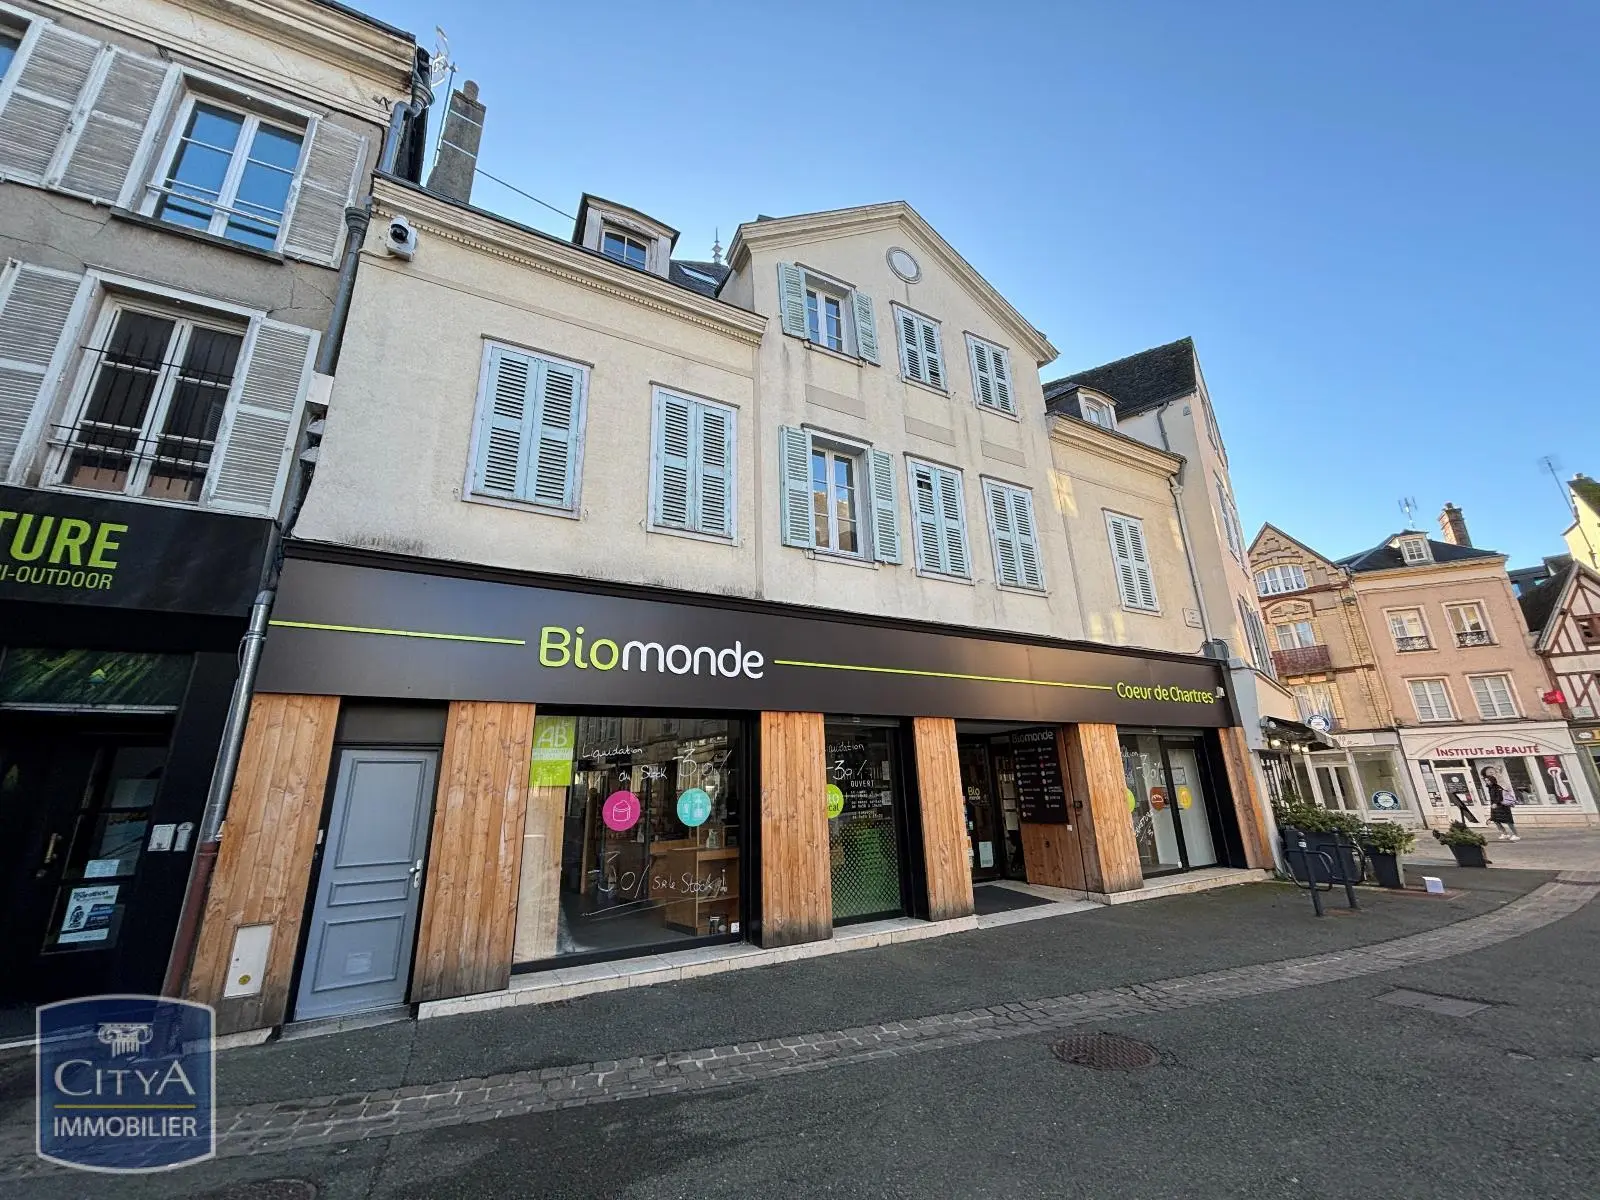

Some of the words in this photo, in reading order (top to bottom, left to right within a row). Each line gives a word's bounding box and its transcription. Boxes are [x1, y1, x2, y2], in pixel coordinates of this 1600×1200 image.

[0, 564, 114, 590] I-OUTDOOR
[538, 625, 765, 680] Biomonde
[1116, 681, 1152, 700] Coeur
[1154, 684, 1170, 701] de
[1169, 687, 1214, 704] Chartres
[1012, 729, 1055, 744] Biomonde
[582, 743, 643, 763] Liquidation
[1435, 747, 1484, 757] INSTITUT
[1495, 743, 1541, 755] BEAUTÉ
[640, 764, 668, 780] Stock
[850, 779, 874, 788] OUVERT
[967, 786, 980, 796] Bio
